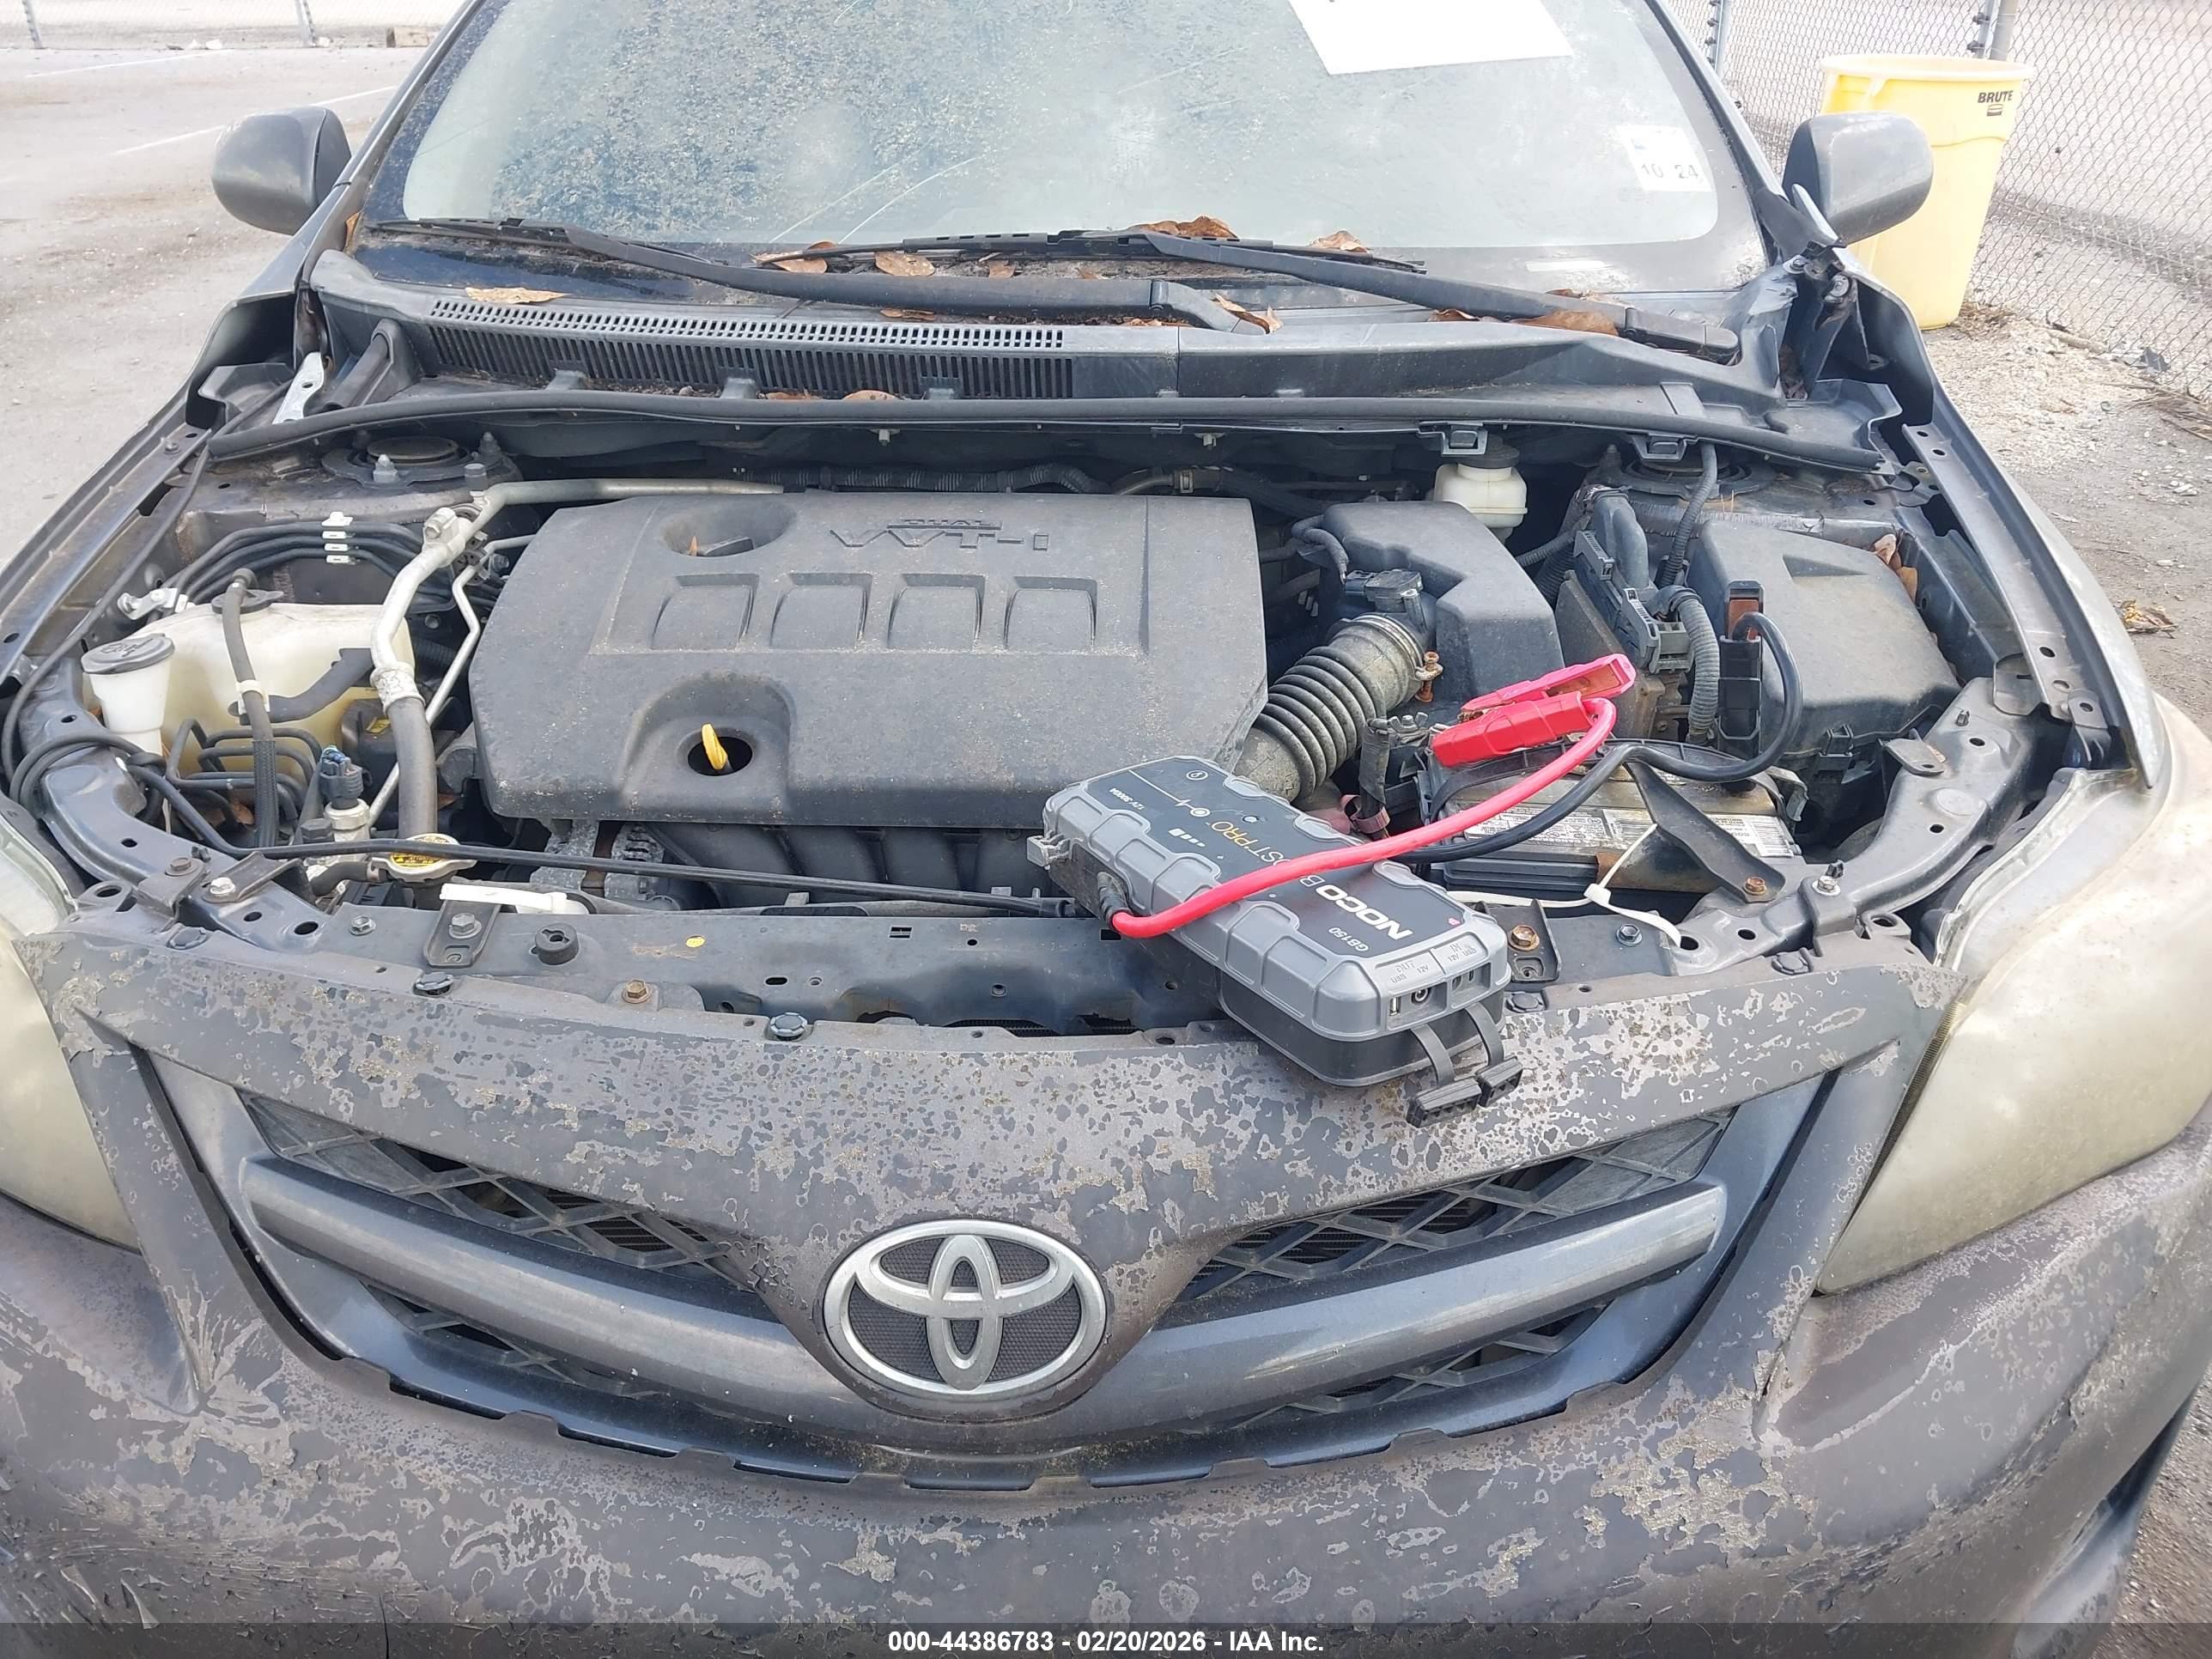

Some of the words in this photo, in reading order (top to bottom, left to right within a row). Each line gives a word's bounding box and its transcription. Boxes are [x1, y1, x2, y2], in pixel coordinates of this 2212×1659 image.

[1977, 90, 2014, 104] BRUTE
[1641, 162, 1664, 179] 10
[1674, 163, 1699, 179] 24
[1211, 821, 1259, 848] PRO
[1248, 846, 1326, 888] BST
[1316, 884, 1414, 940] NOCO
[1328, 927, 1370, 951] GB150
